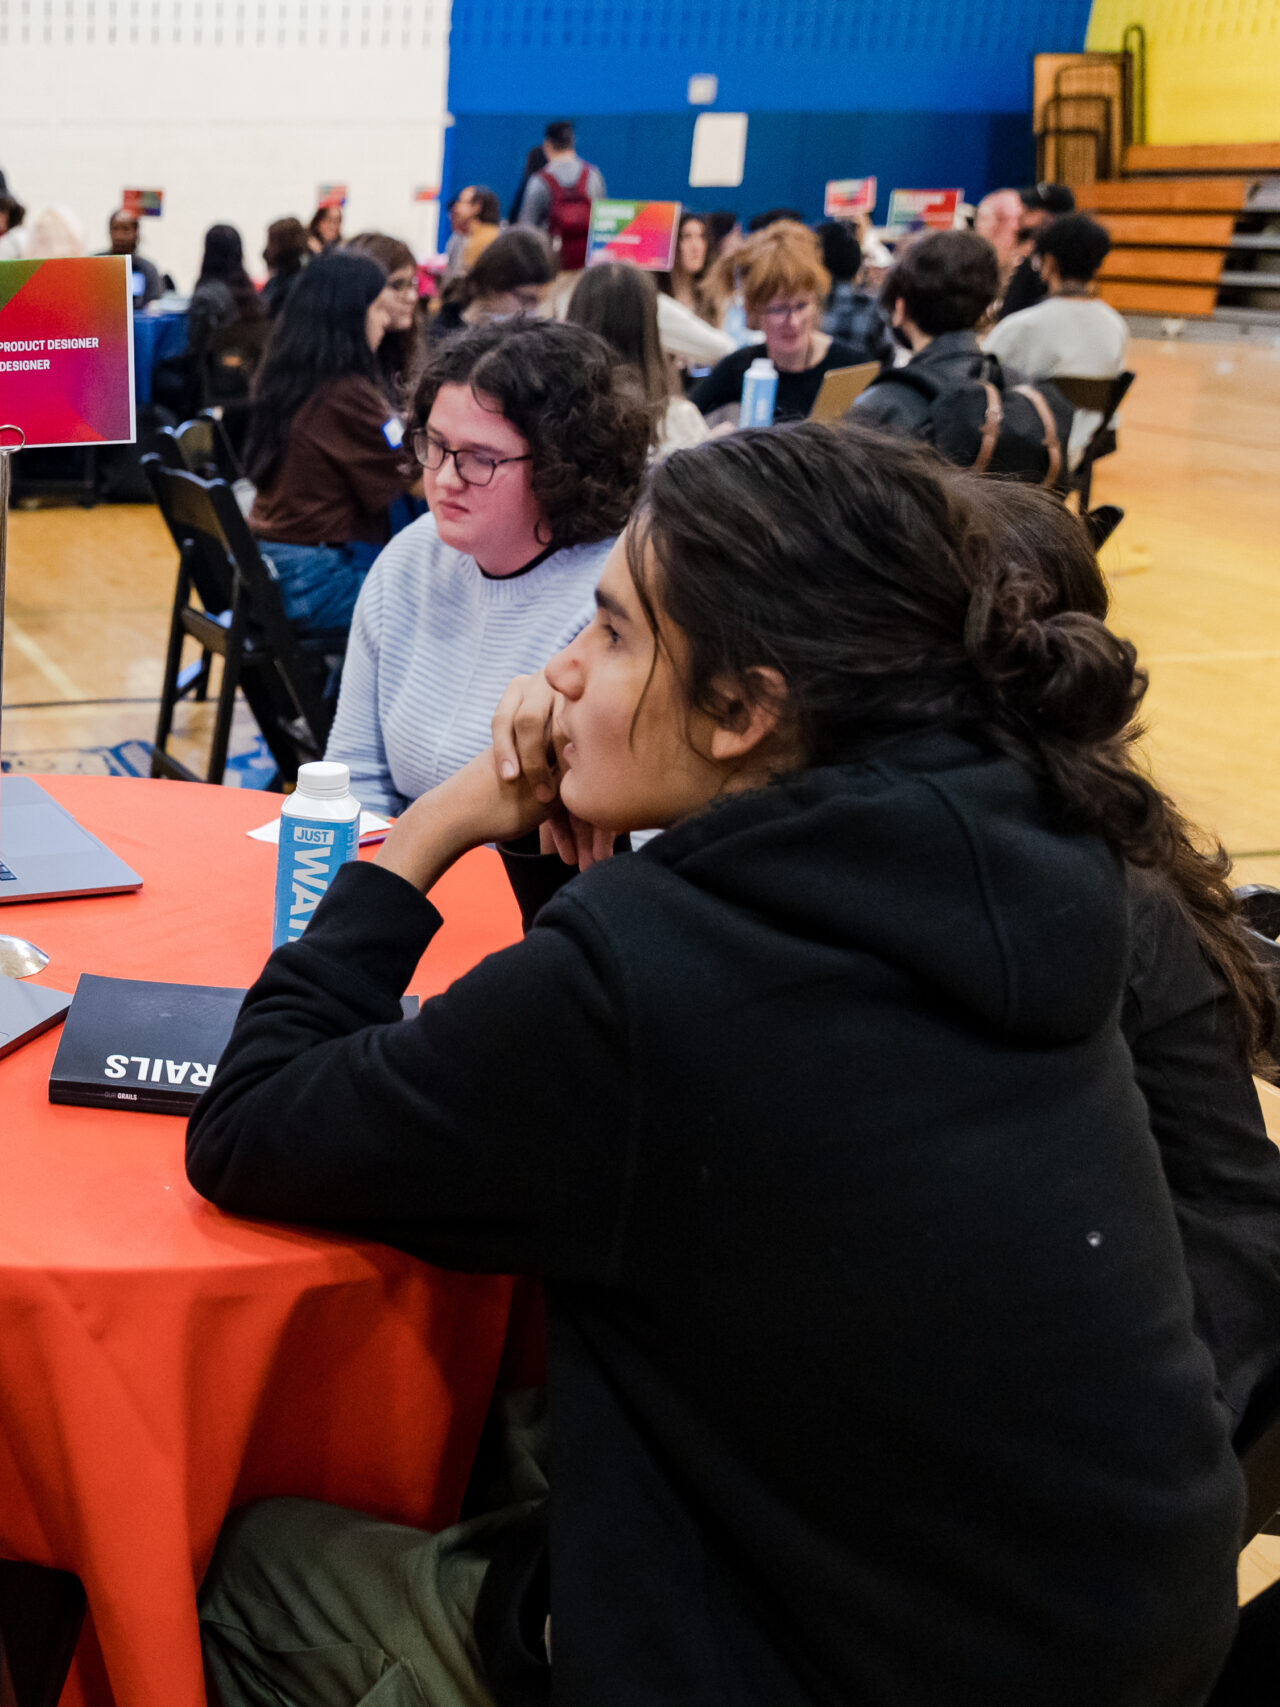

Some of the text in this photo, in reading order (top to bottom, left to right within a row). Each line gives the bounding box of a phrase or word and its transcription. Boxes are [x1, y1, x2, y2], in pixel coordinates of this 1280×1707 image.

[47, 337, 99, 350] DESIGNER
[296, 829, 329, 843] JUST
[104, 1054, 217, 1087] RAILS
[117, 1092, 138, 1101] GRAILS
